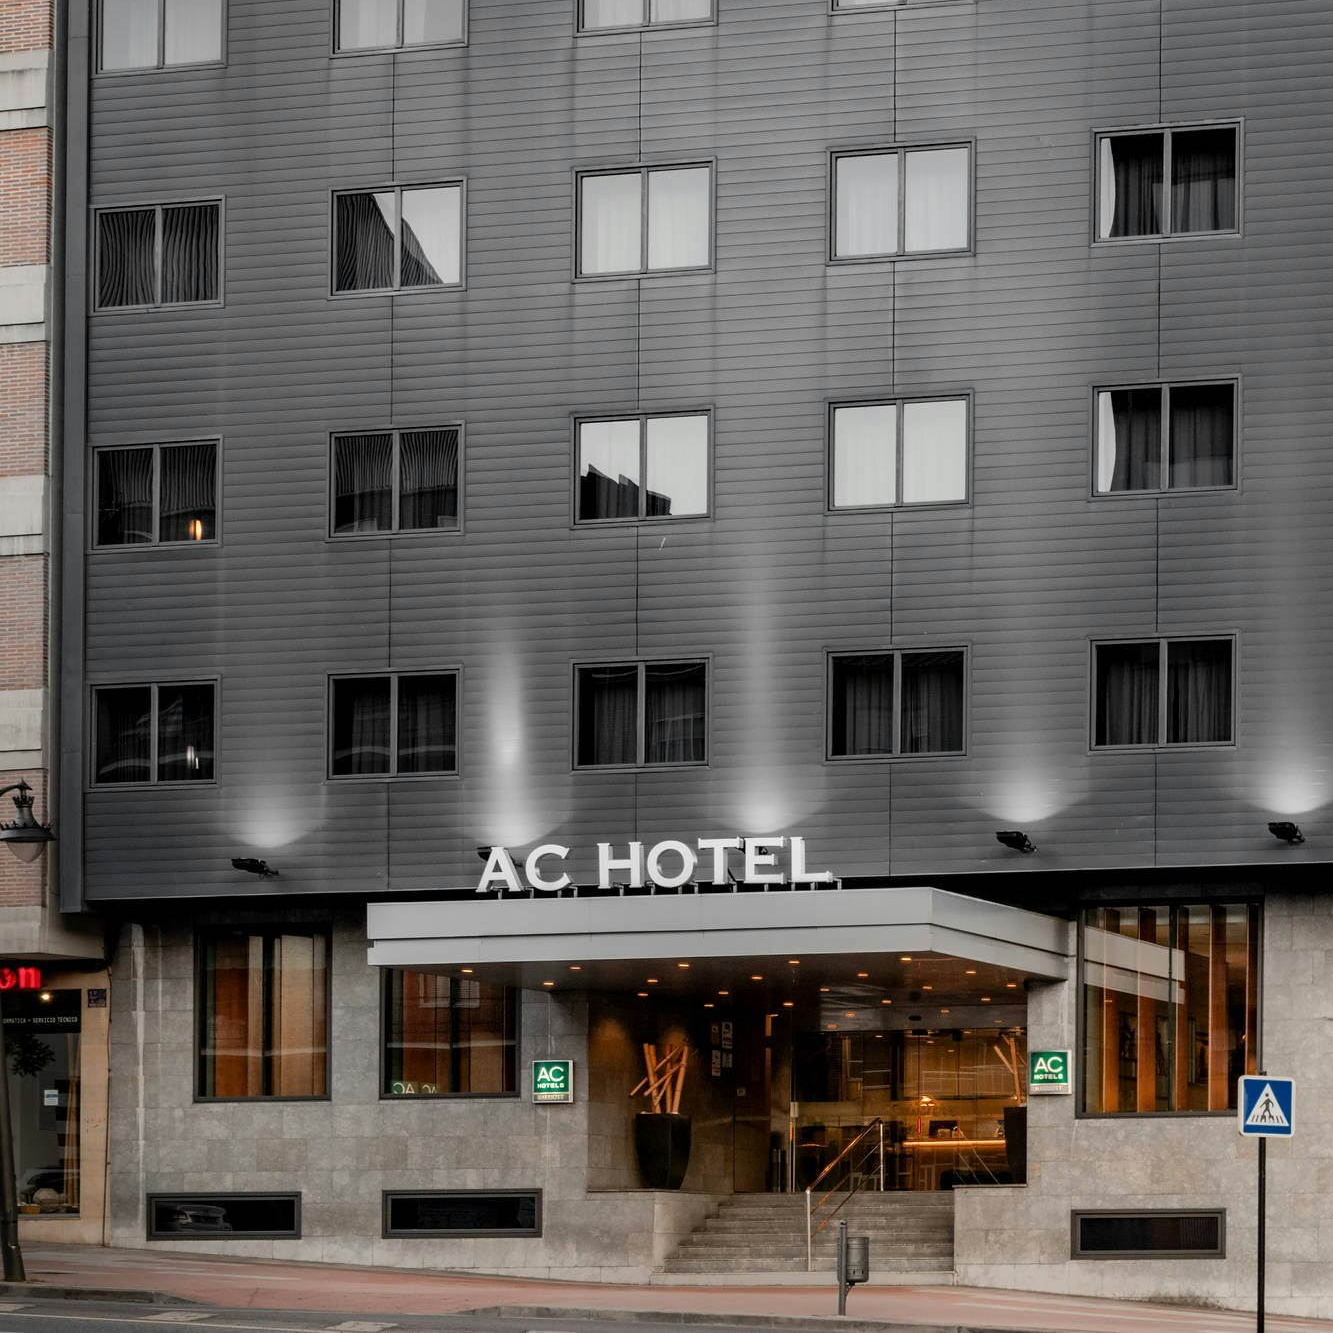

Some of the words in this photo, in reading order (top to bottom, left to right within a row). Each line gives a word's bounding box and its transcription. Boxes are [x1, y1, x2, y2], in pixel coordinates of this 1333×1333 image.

[475, 844, 574, 893] AC
[597, 836, 835, 889] HOTEL
[1034, 1056, 1063, 1073] AC
[537, 1066, 564, 1082] AC
